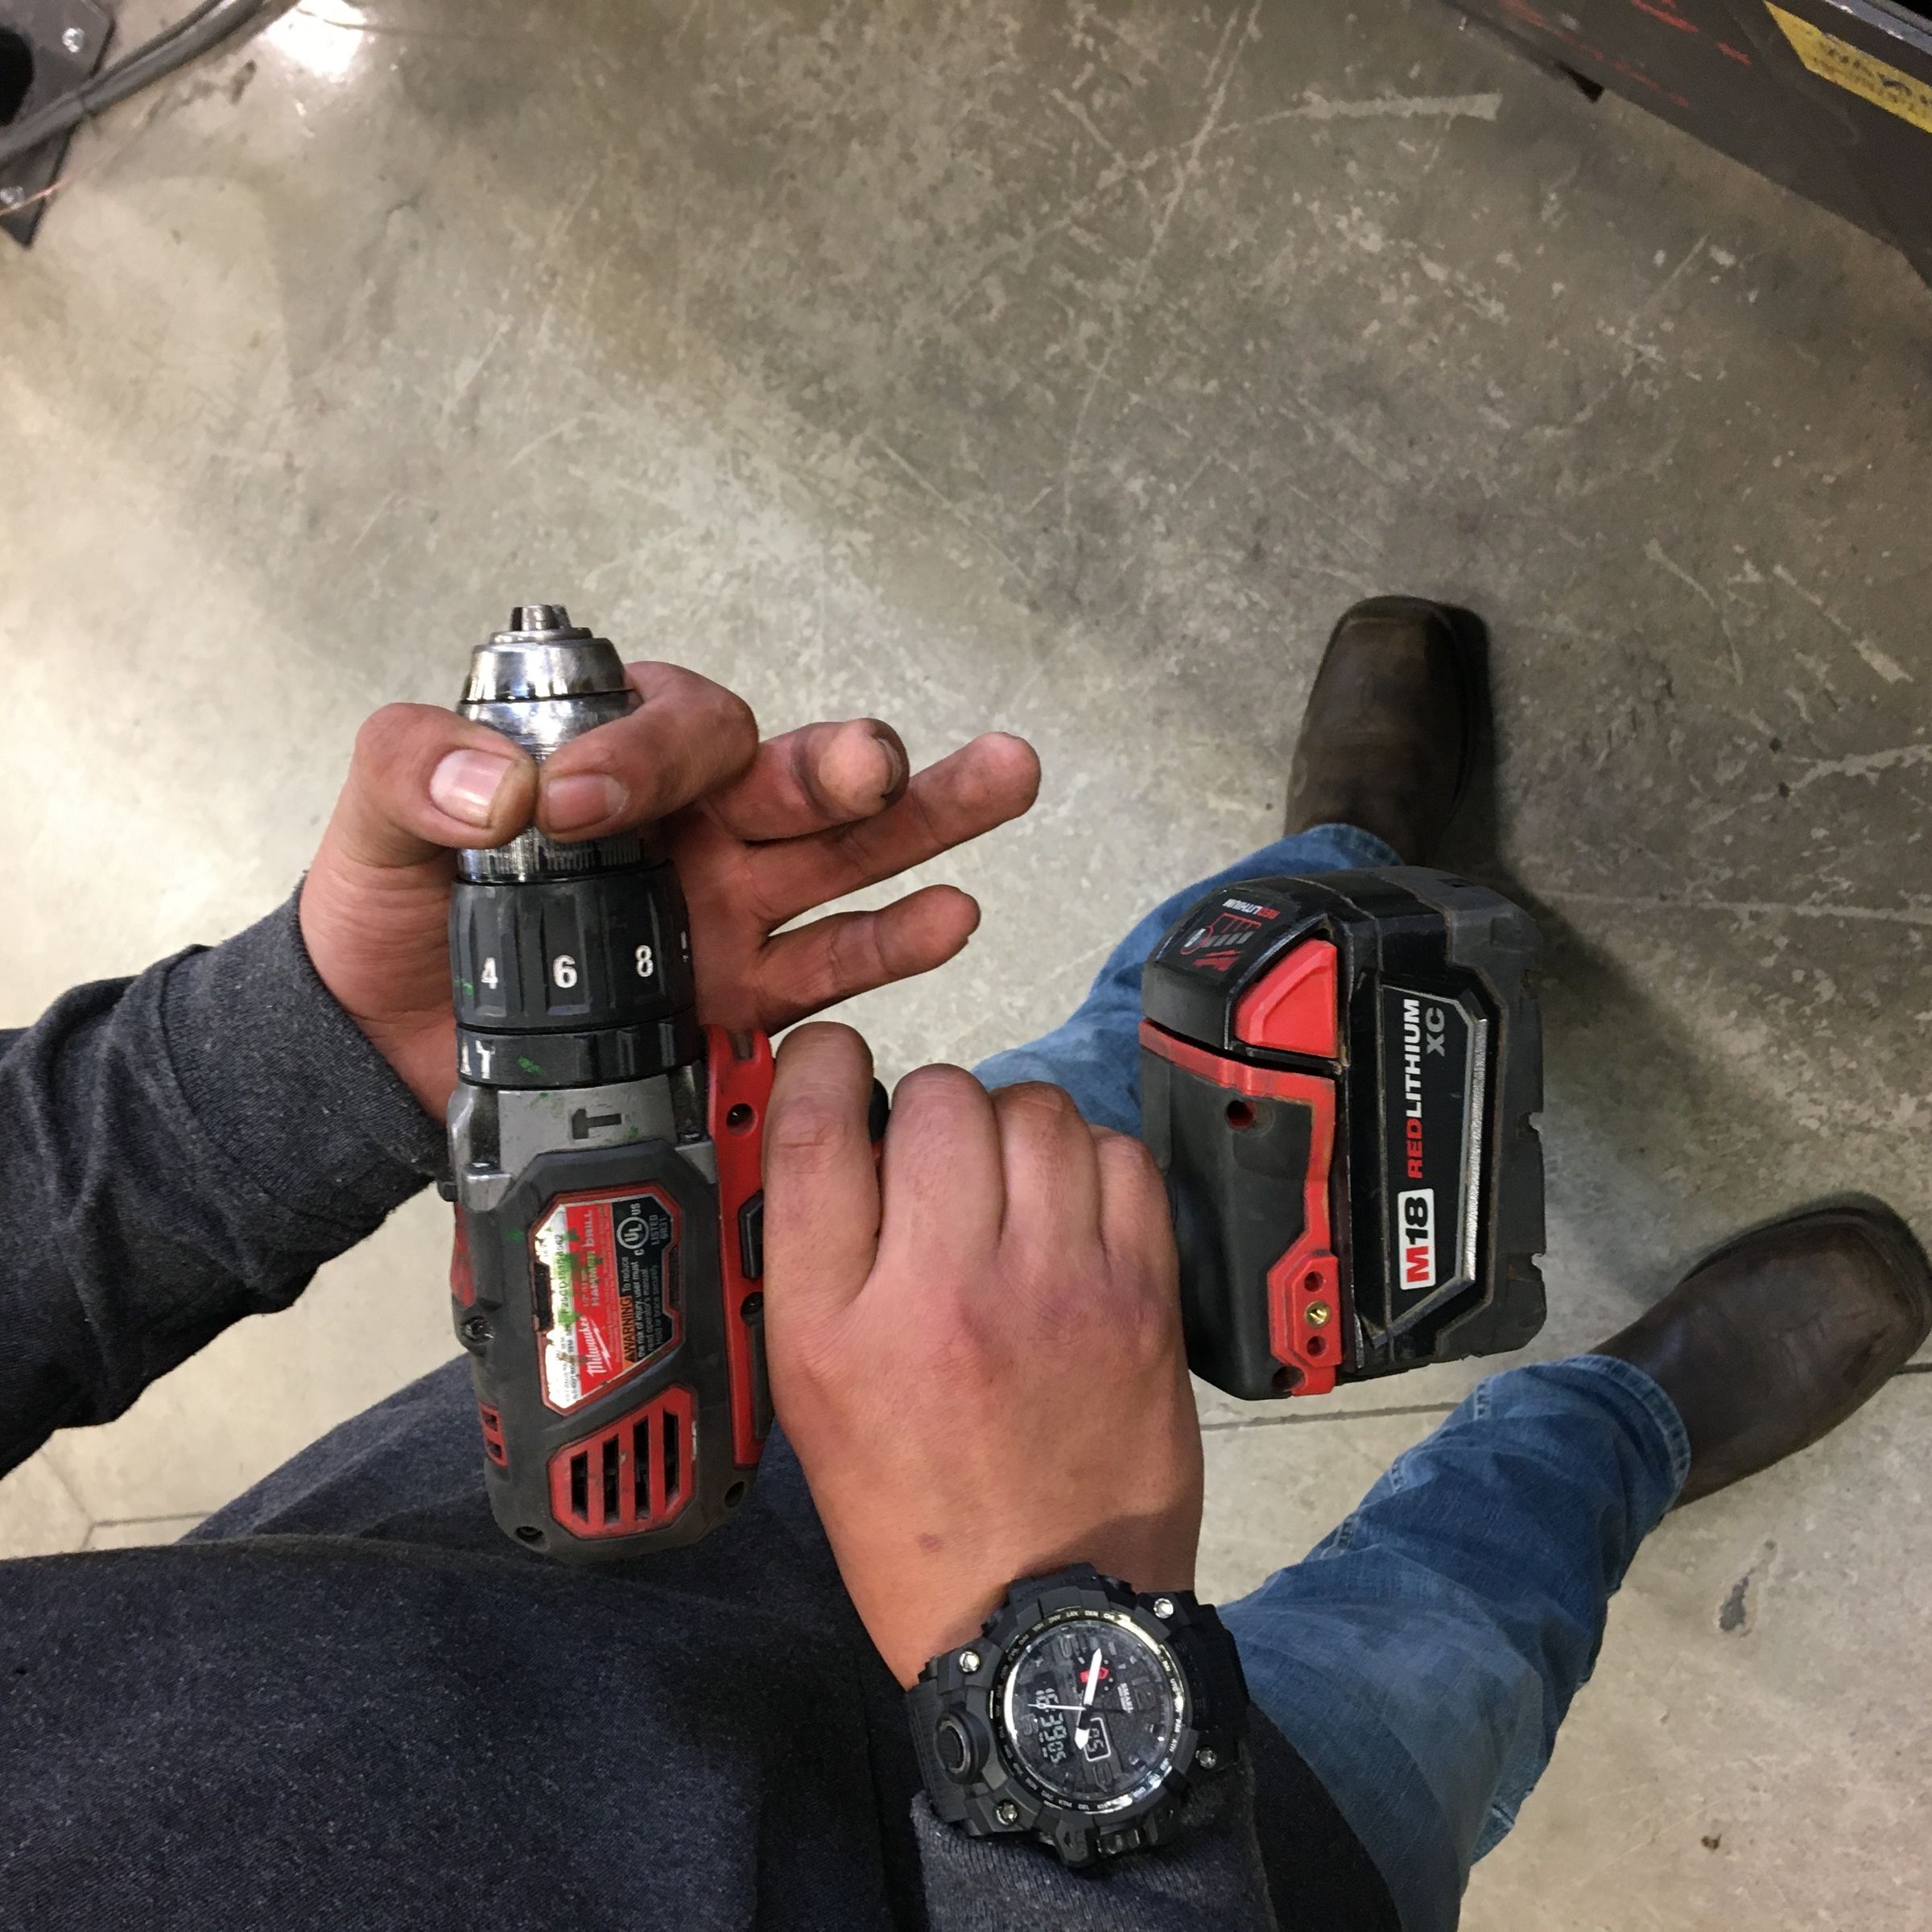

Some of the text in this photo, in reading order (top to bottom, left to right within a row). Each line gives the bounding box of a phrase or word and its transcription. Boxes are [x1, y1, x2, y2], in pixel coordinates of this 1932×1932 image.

[481, 956, 498, 989] 4
[552, 954, 578, 989] 6
[635, 944, 654, 977] 8
[1425, 1006, 1446, 1058] XC
[1403, 998, 1430, 1283] M18 REDLITHIUM
[630, 1203, 642, 1216] US
[624, 1224, 643, 1243] UL
[648, 1214, 661, 1246] LISTED
[587, 1250, 600, 1307] HAMMER
[620, 1256, 630, 1282] reduce
[630, 1261, 640, 1281] must
[633, 1282, 642, 1298] user
[652, 1296, 662, 1318] brace
[619, 1297, 637, 1352] WARNING
[636, 1331, 645, 1344] risk
[577, 1314, 608, 1378] Milwaukee
